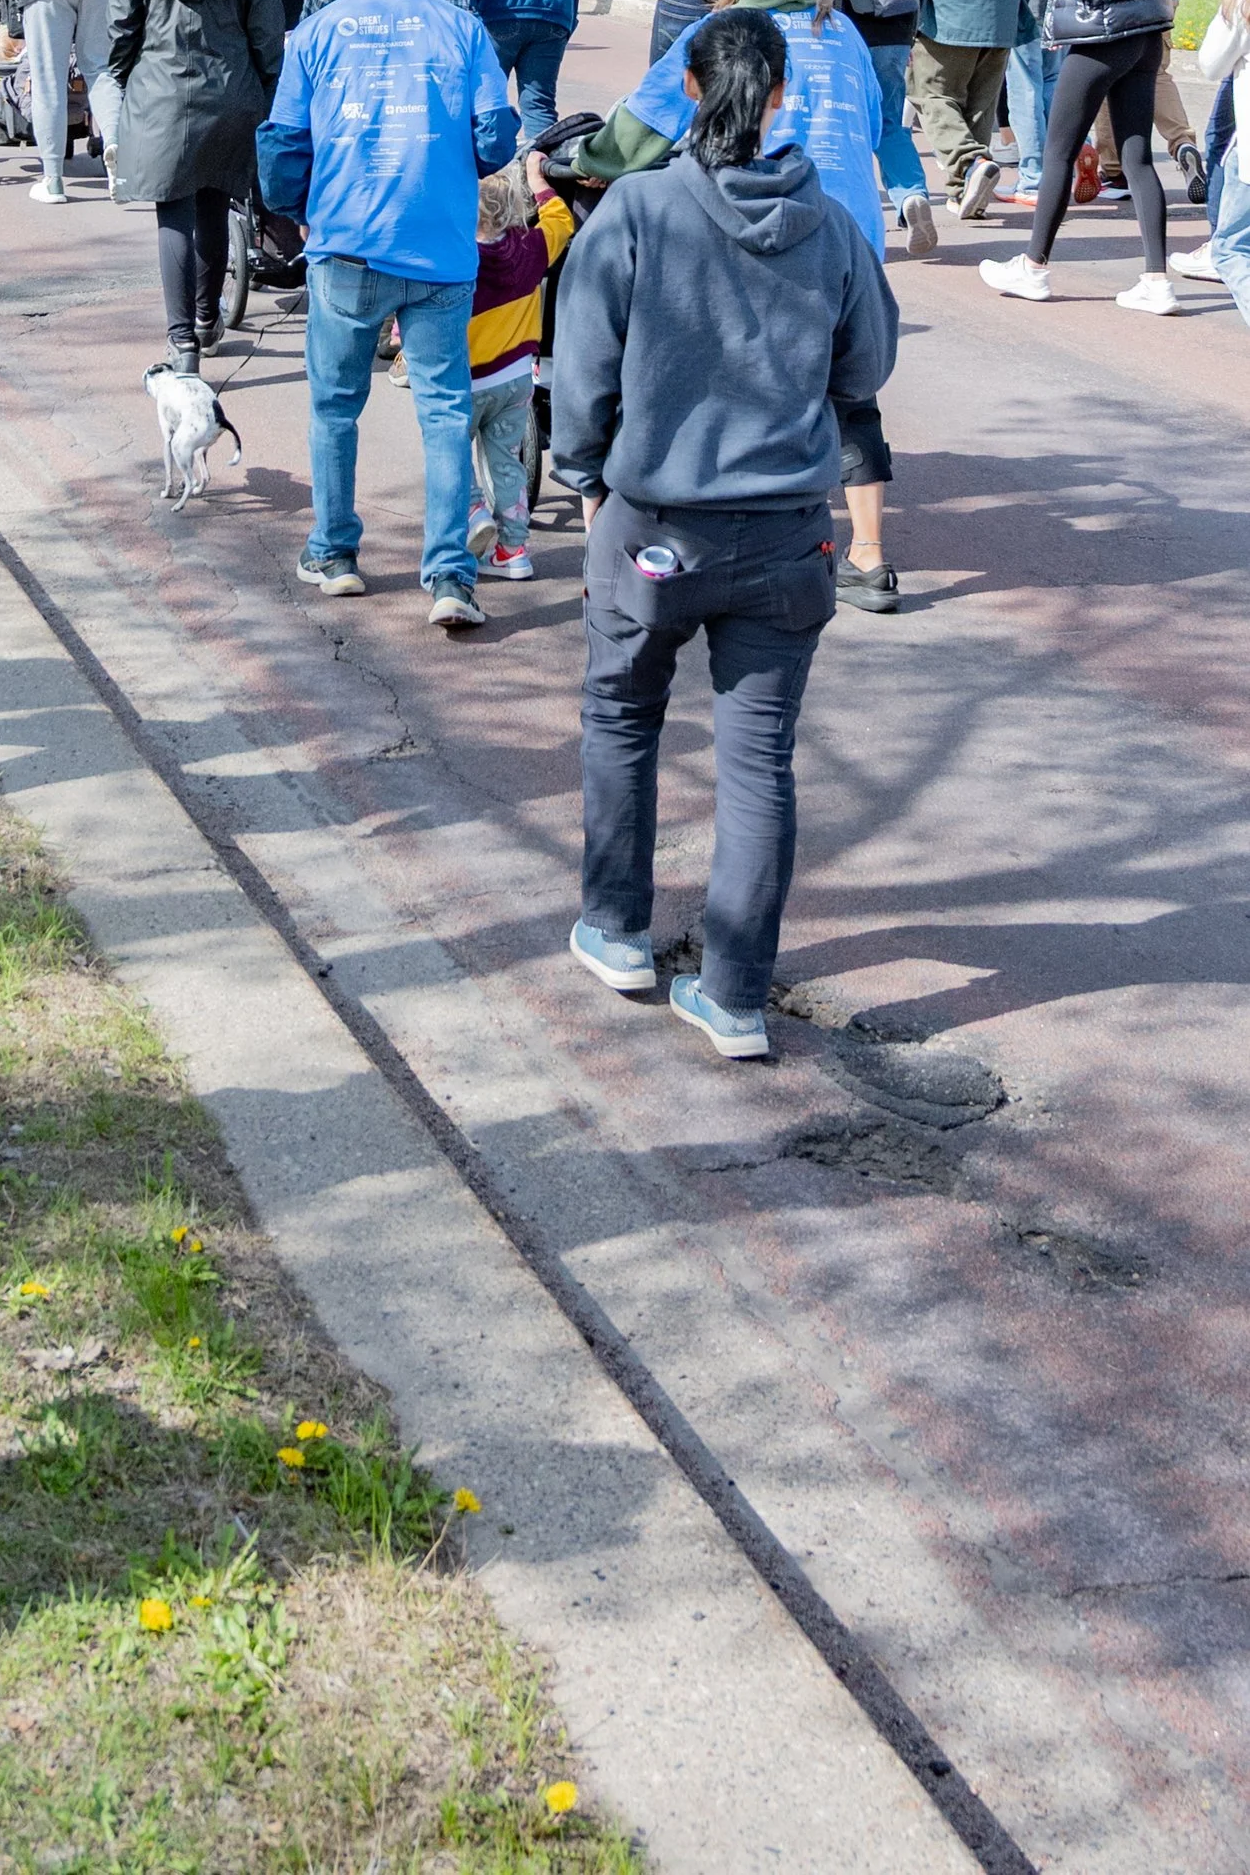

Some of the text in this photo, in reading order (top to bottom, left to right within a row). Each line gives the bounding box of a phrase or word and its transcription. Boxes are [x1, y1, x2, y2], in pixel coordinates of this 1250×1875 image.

[358, 15, 382, 24] GREAT
[791, 12, 811, 20] GREAT
[359, 25, 389, 35] STRIDES
[396, 105, 427, 114] natera
[833, 101, 857, 113] natera
